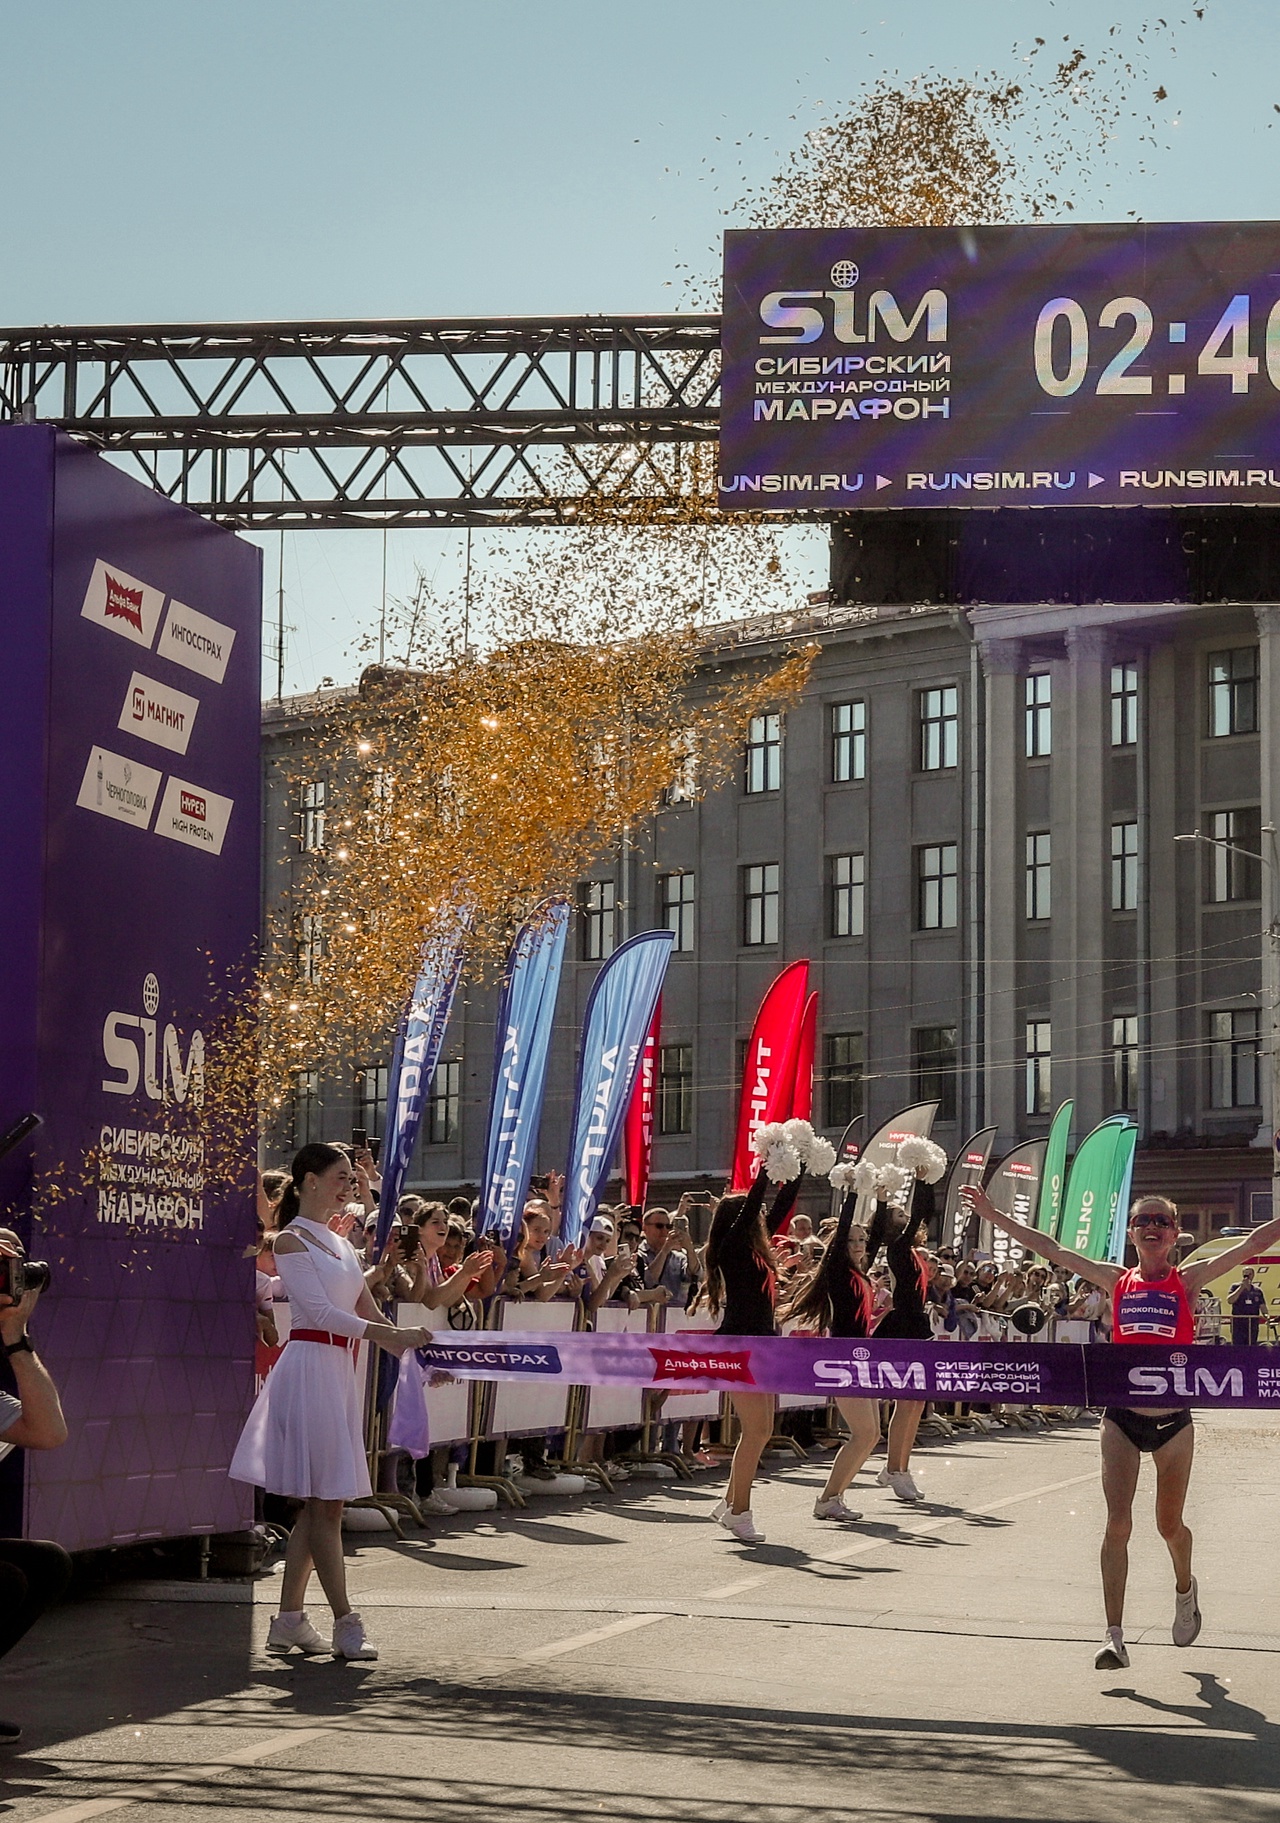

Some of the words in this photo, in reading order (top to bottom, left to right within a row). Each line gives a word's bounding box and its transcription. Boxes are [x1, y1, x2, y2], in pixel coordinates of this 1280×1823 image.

[755, 352, 951, 375] СИБИРСКИЙ
[755, 377, 951, 394] МЕЖДУНАРОДНЫЙ
[753, 397, 950, 421] МАРАФОН
[906, 471, 1075, 490] RUNSIM.RU
[171, 622, 222, 661] ИНГОССТРАХ
[147, 700, 185, 732] МАГНИТ
[181, 795, 205, 816] HYPER
[172, 817, 188, 833] HIGH
[189, 823, 214, 842] PROTEIN
[98, 1189, 204, 1230] МАРАФОН
[1121, 1306, 1175, 1316] ПРОКОПЬЕВА
[420, 1349, 550, 1366] ИНГОССТРАХ
[664, 1358, 707, 1371] Альфа
[709, 1359, 742, 1370] Банк
[934, 1361, 1040, 1372] СИБИРСКИЙ
[935, 1372, 1040, 1380] МЕЖДУНАРОДНЫЙ
[936, 1380, 1041, 1393] МАРАФОН
